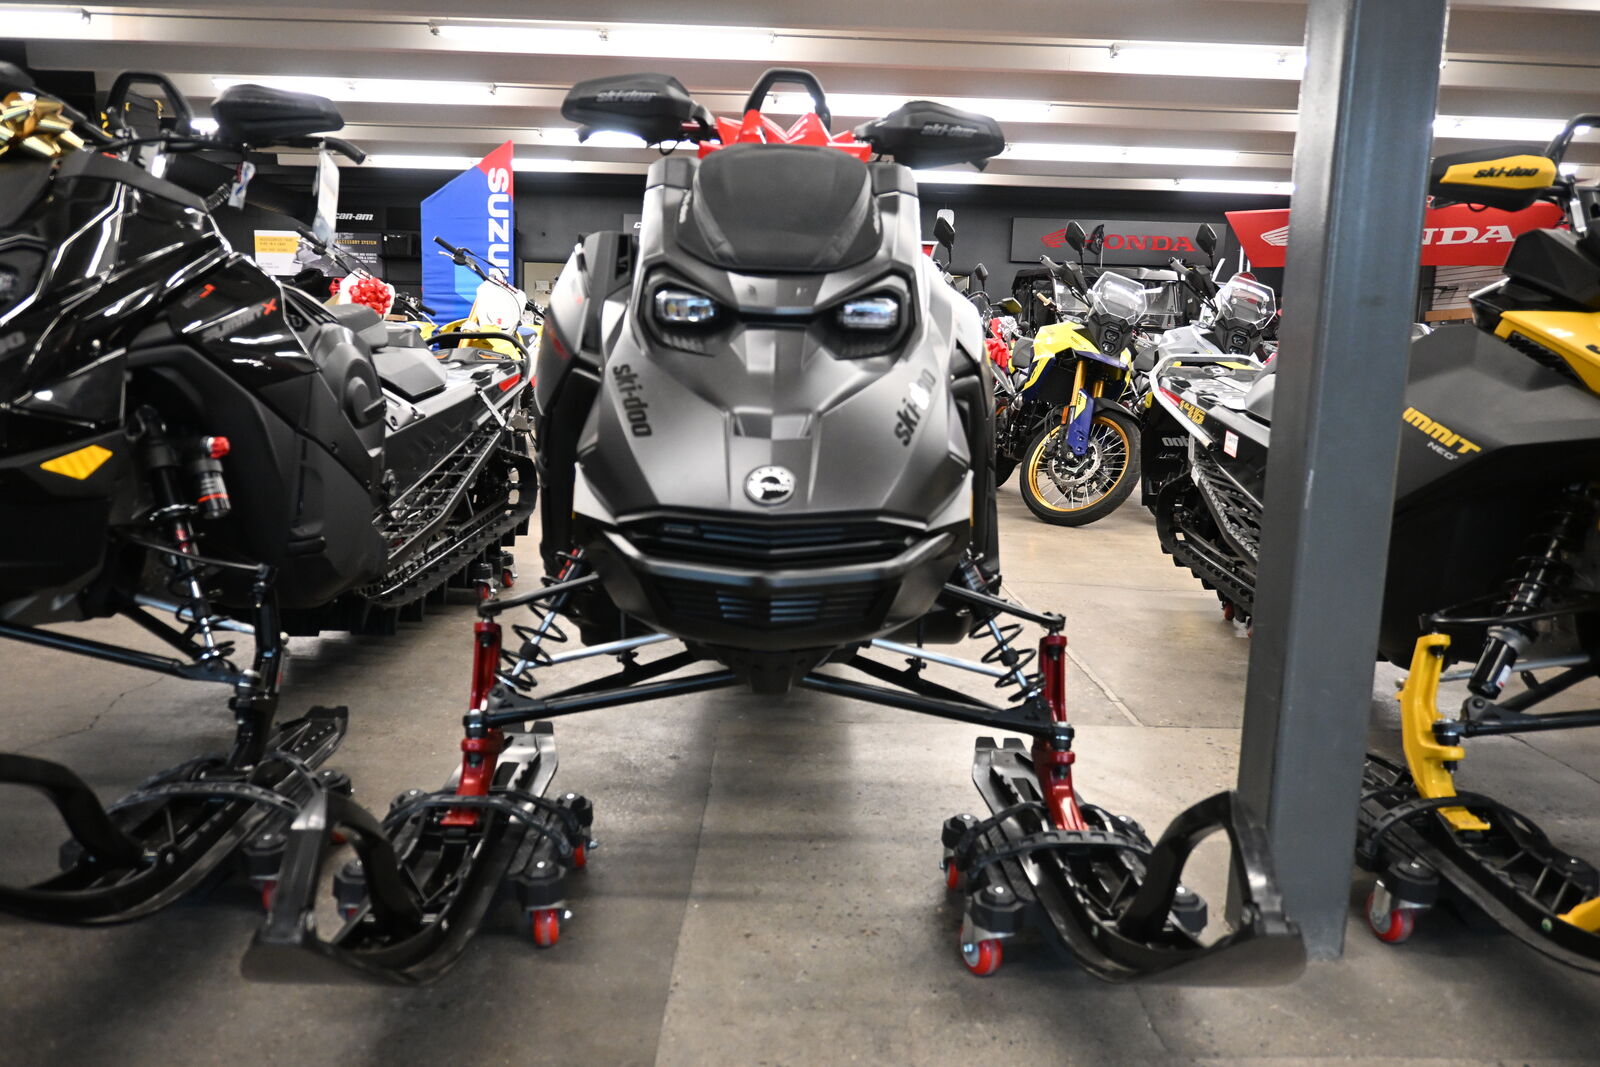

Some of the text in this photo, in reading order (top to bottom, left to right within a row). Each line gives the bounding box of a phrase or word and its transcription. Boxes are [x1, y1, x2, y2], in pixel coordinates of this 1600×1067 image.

[1473, 167, 1539, 178] ski-doo
[487, 167, 510, 278] SUZU
[612, 363, 653, 438] ski-doo
[894, 367, 937, 448] ski-oo
